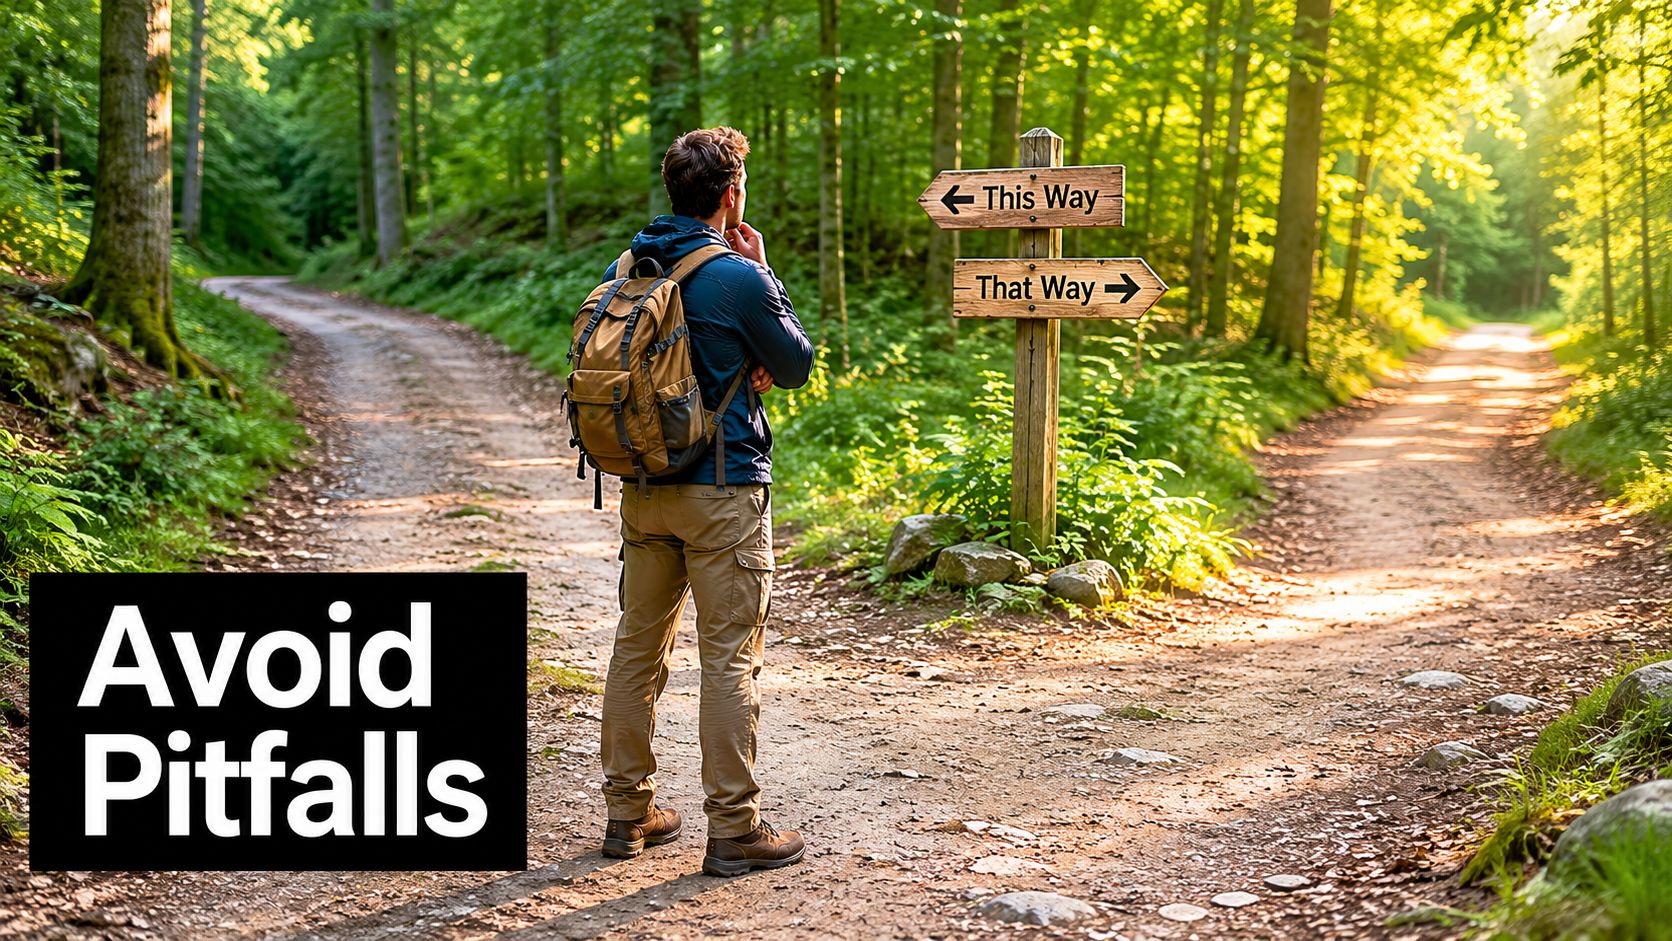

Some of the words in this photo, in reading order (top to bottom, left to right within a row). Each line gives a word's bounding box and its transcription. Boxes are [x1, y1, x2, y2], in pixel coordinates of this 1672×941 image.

[983, 185, 1035, 210] This
[1044, 184, 1099, 215] Way
[976, 275, 1033, 300] That
[1041, 275, 1096, 306] Way
